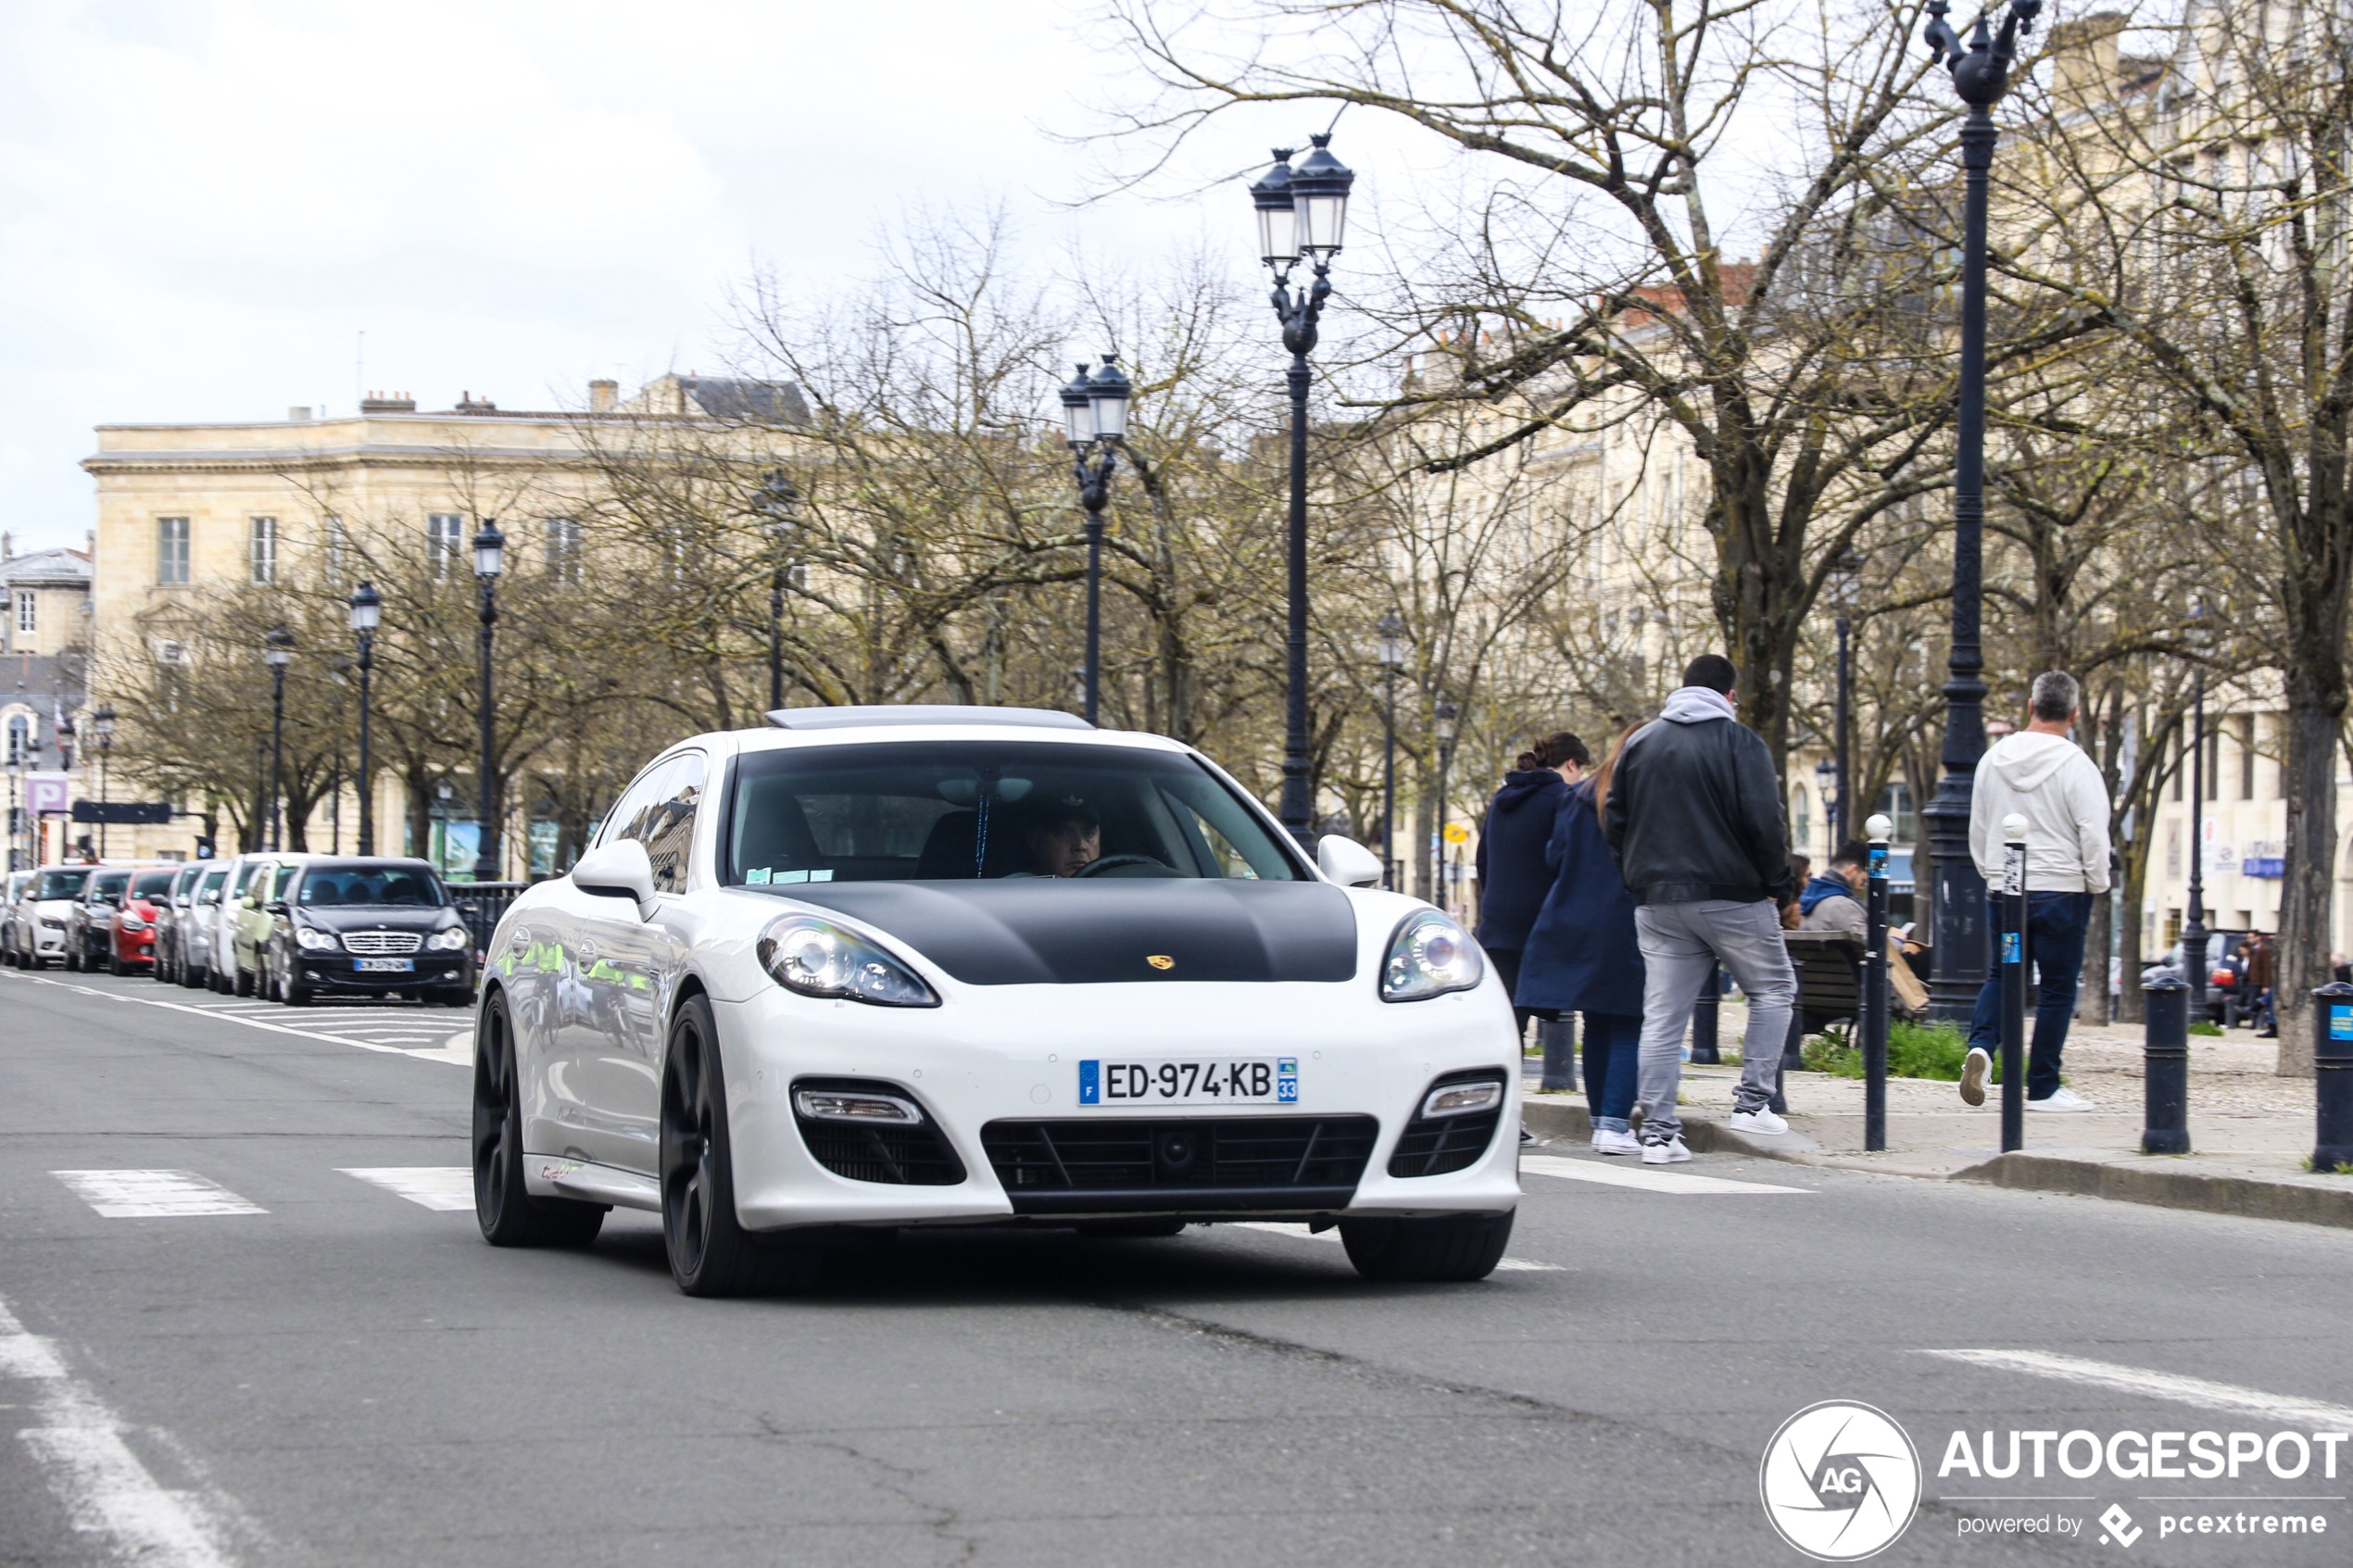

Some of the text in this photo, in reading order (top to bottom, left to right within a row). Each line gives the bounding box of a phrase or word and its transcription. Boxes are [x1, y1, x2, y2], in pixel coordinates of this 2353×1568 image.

[35, 783, 62, 811] P
[1085, 1086, 1093, 1097] F
[1107, 1062, 1271, 1098] ED-974-KB
[1278, 1080, 1296, 1098] 33
